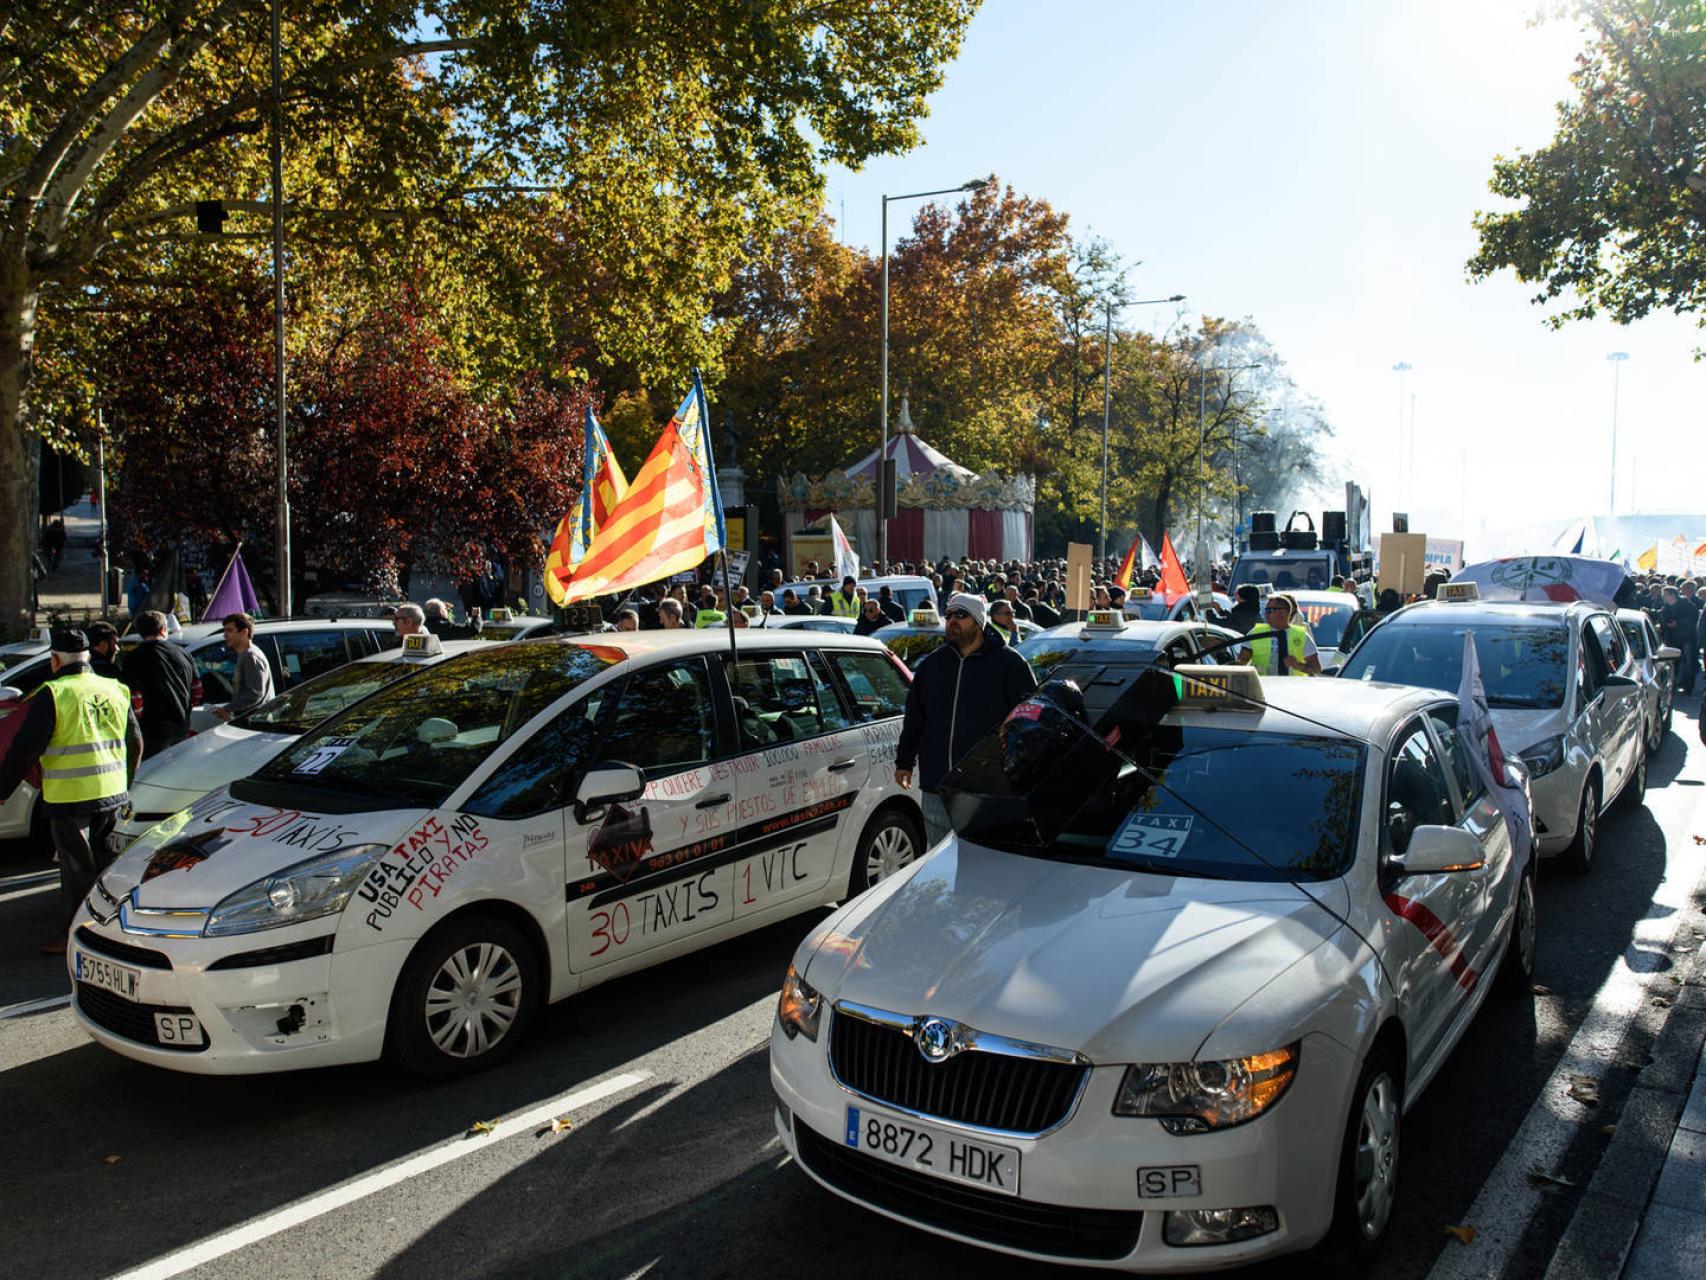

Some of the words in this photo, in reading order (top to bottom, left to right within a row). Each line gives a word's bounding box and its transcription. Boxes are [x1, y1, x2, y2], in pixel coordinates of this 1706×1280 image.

[1095, 614, 1111, 625] TAXI
[407, 636, 421, 649] TAXI
[1189, 676, 1227, 697] TAXI
[645, 780, 658, 800] PP
[662, 770, 704, 797] QUIERE
[709, 755, 760, 782] DESTRUIR
[802, 736, 843, 755] FAMILIAS
[227, 807, 301, 838] 30
[680, 816, 689, 838] Y
[696, 811, 720, 834] SUS
[727, 792, 777, 823] PUESTOS
[783, 786, 797, 807] DE
[1136, 816, 1190, 829] TAXI
[586, 830, 654, 872] TAXIVA
[1116, 829, 1178, 855] 34
[358, 861, 398, 903] USA
[393, 816, 443, 860] TAXI
[366, 846, 434, 931] PUBLICO
[435, 830, 451, 853] Y
[450, 814, 479, 841] NO
[407, 829, 489, 911] PIRATAS
[590, 901, 630, 957] 30
[636, 868, 719, 936] TAXIS
[742, 863, 756, 904] 1
[762, 843, 808, 892] VTC
[81, 957, 112, 987] 5755
[160, 1017, 193, 1041] SP
[866, 1119, 934, 1166] 8872
[949, 1140, 1005, 1187] HDK
[1146, 1171, 1193, 1192] SP
